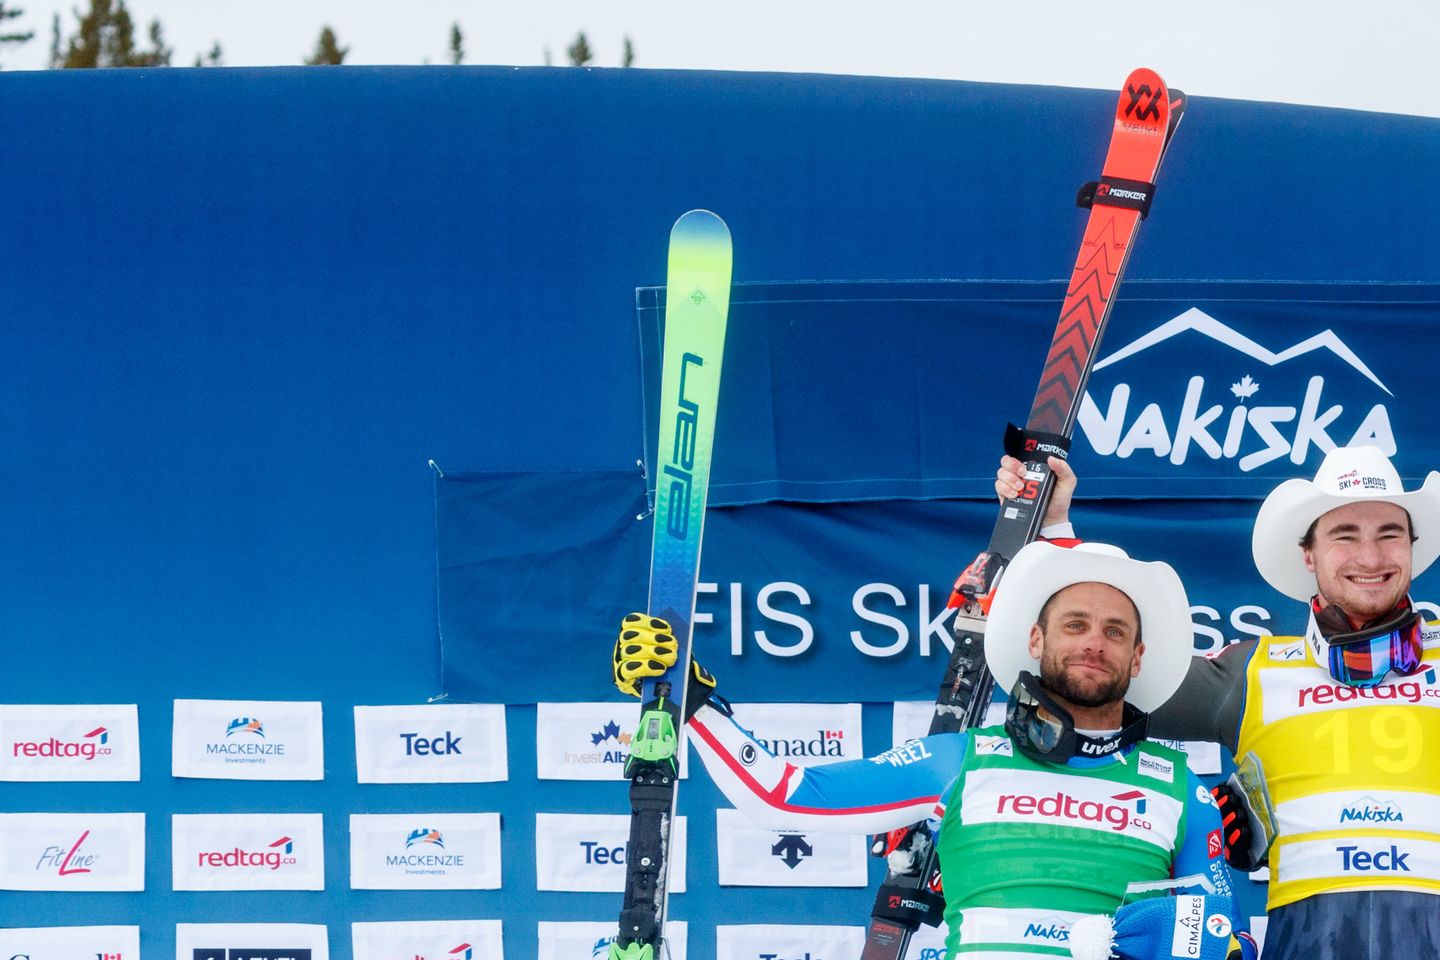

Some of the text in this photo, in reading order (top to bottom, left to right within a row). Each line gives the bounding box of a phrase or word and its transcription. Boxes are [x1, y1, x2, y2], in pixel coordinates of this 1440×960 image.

[666, 351, 704, 541] elan
[850, 581, 954, 657] Sk
[14, 737, 111, 760] redtag.ca
[207, 744, 284, 755] MACKENZIE
[400, 731, 462, 756] Teck
[766, 737, 845, 757] anada
[1081, 736, 1122, 755] uvex
[1313, 706, 1424, 775] 19
[997, 792, 1152, 831] redtag.ca
[199, 847, 296, 870] redtag.ca
[387, 855, 463, 866] MACKENZIE
[580, 842, 627, 865] Tec
[1336, 846, 1410, 871] Teck
[1188, 897, 1202, 955] CIMALPES
